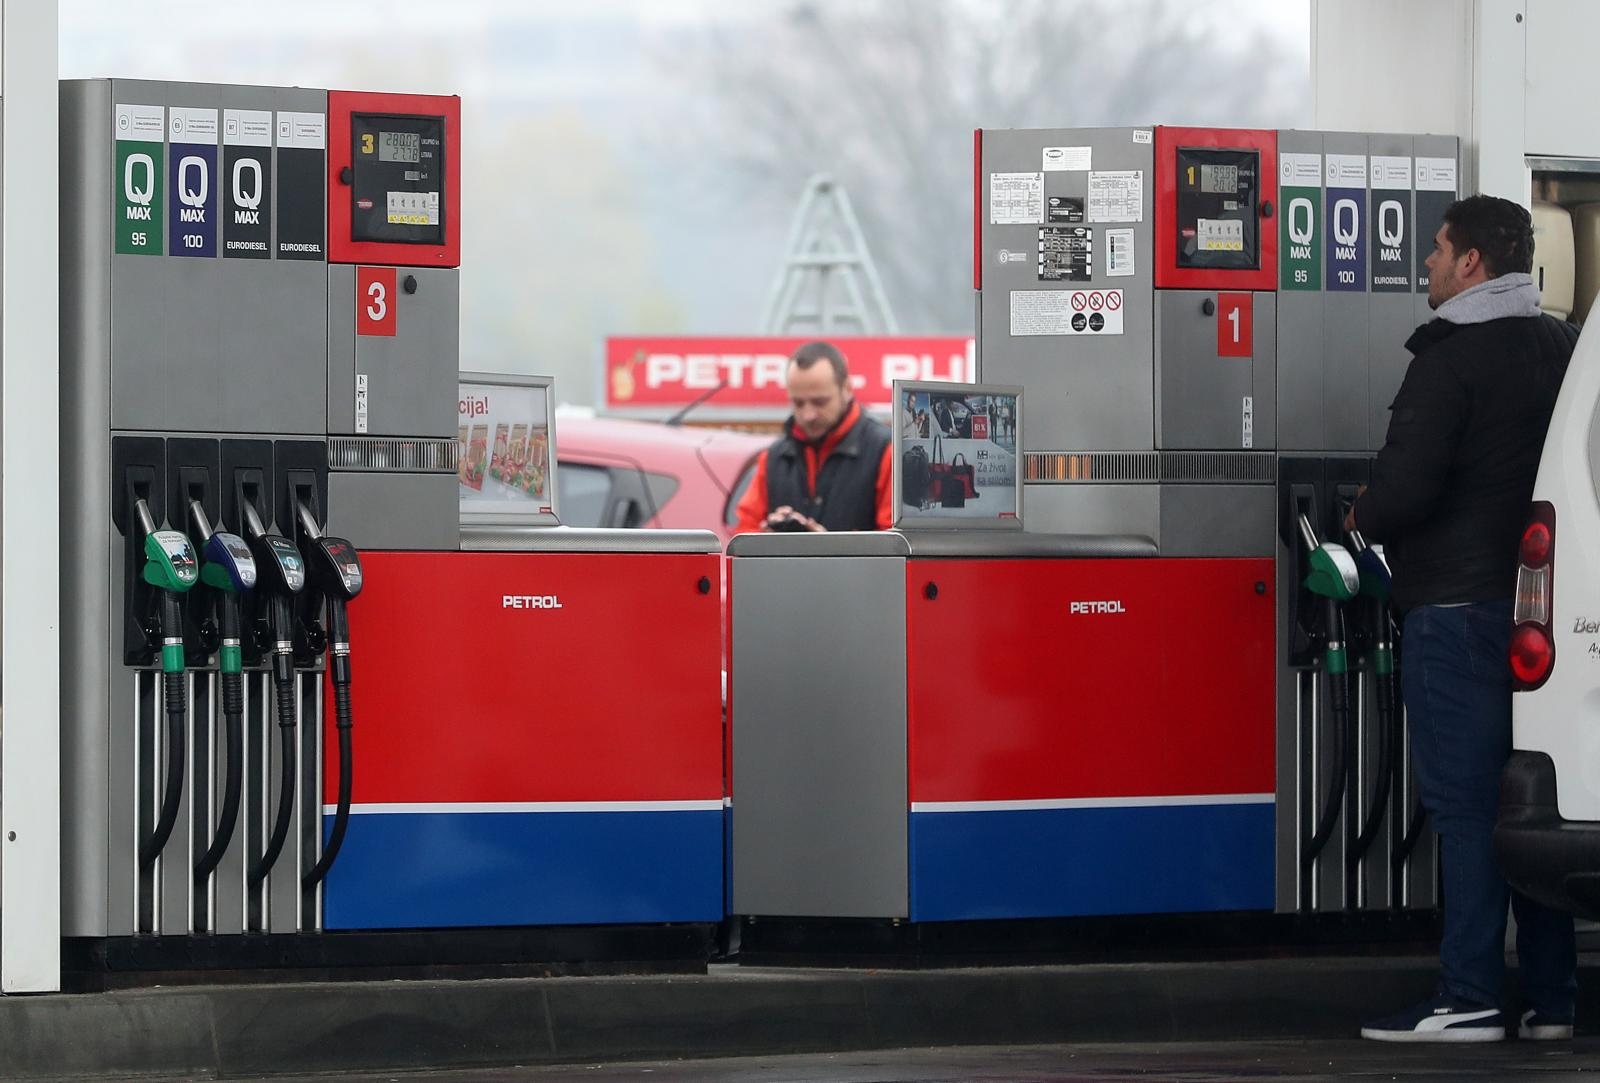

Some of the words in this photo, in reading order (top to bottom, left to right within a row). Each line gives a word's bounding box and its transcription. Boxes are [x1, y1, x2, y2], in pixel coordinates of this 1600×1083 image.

[362, 134, 374, 154] 3
[124, 153, 155, 205] Q
[178, 155, 209, 208] Q
[1187, 166, 1195, 185] 1
[232, 158, 263, 210] Q
[126, 206, 151, 220] MAX
[180, 208, 205, 223] MAX
[234, 210, 260, 225] MAX
[1288, 197, 1314, 246] Q
[1333, 198, 1359, 247] Q
[1378, 200, 1404, 248] Q
[131, 232, 147, 246] 95
[182, 234, 203, 248] 100
[226, 241, 268, 251] EURODIESEL
[280, 243, 321, 252] EURODIESEL
[1290, 246, 1311, 259] MAX
[1335, 248, 1356, 261] MAX
[1380, 249, 1401, 261] MAX
[1294, 270, 1308, 283] 95
[1338, 271, 1355, 283] 100
[1374, 276, 1408, 285] EURODIESEL
[367, 281, 387, 321] 3
[1228, 306, 1240, 343] 1
[646, 353, 866, 389] PETR
[977, 462, 988, 473] Za
[503, 595, 563, 608] PETROL
[1070, 600, 1126, 614] PETROL
